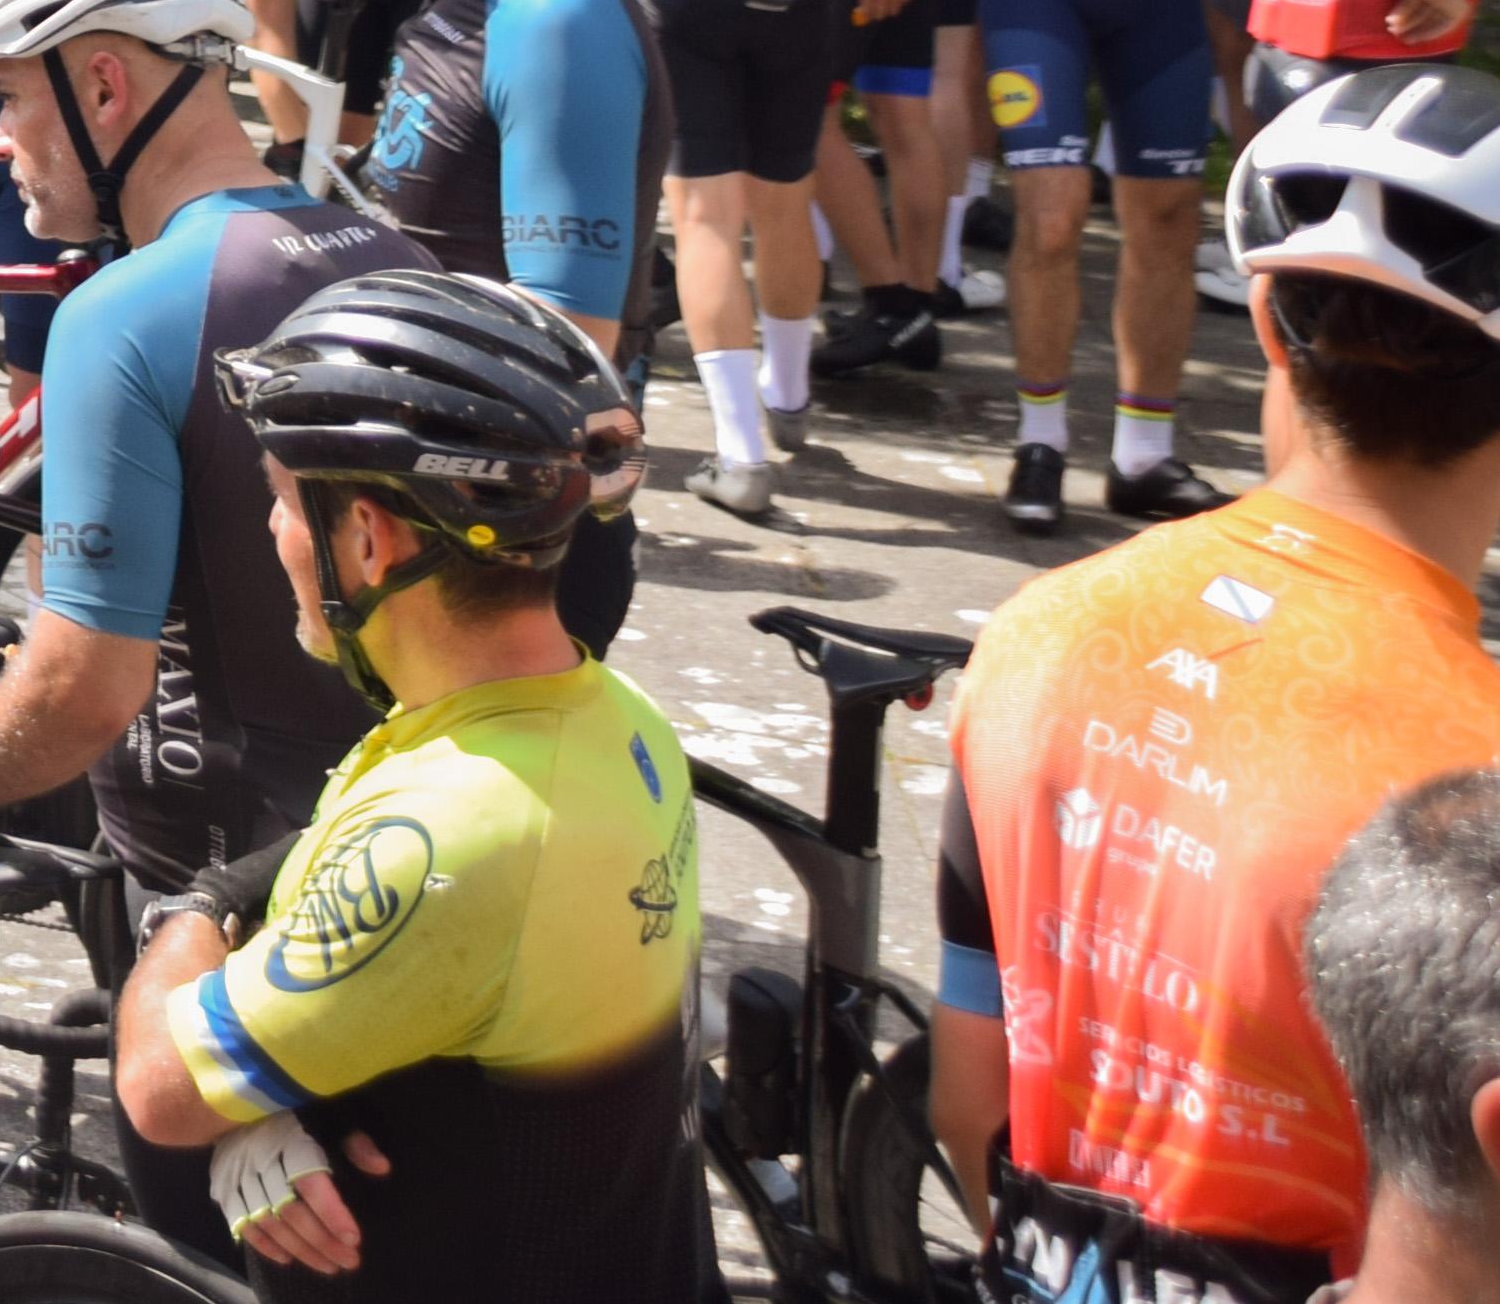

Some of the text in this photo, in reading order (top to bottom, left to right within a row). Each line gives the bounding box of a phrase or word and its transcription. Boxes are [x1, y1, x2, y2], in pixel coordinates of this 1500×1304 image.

[412, 453, 512, 482] BELL
[1145, 646, 1221, 701] AXA
[1082, 718, 1229, 807] DARLIM
[1111, 803, 1218, 881] DAFER
[1090, 1046, 1207, 1124] SOUTO
